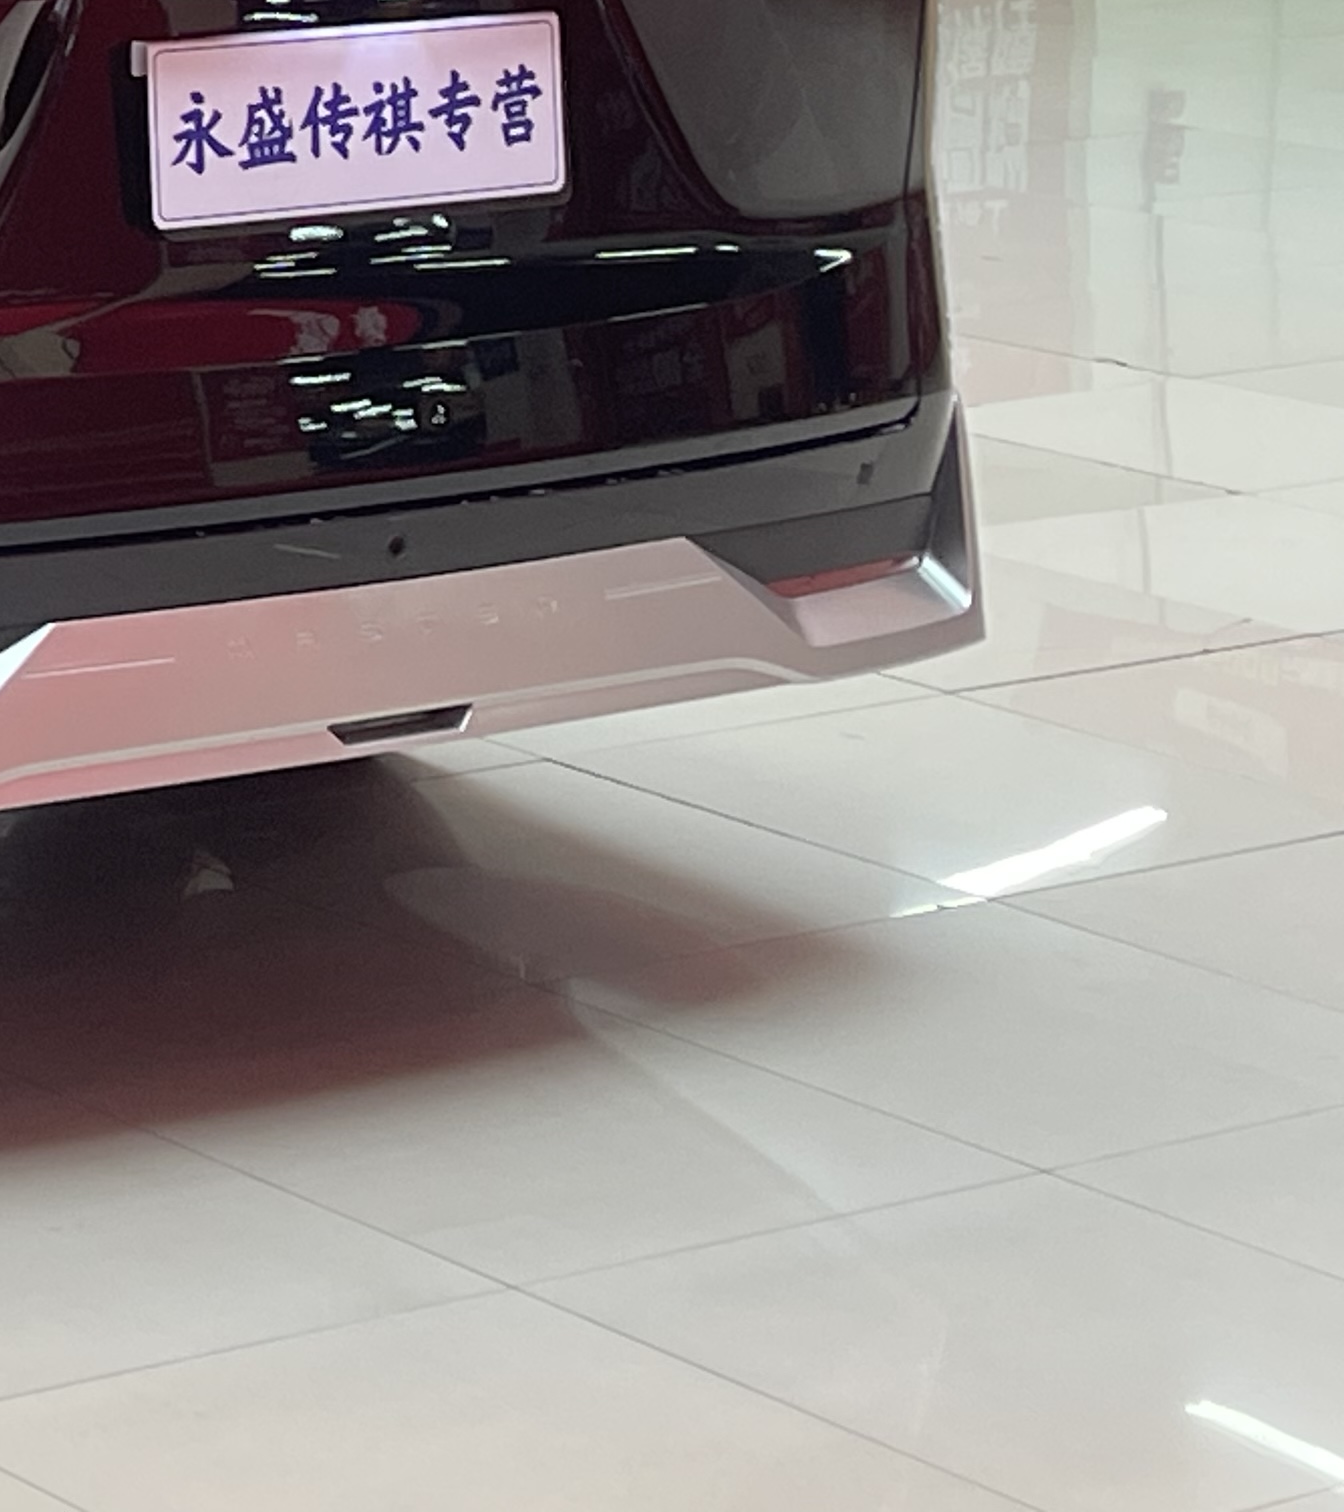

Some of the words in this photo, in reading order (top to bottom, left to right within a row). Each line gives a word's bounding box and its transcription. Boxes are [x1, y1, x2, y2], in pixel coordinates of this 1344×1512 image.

[170, 63, 544, 175] 永盛传祺专营
